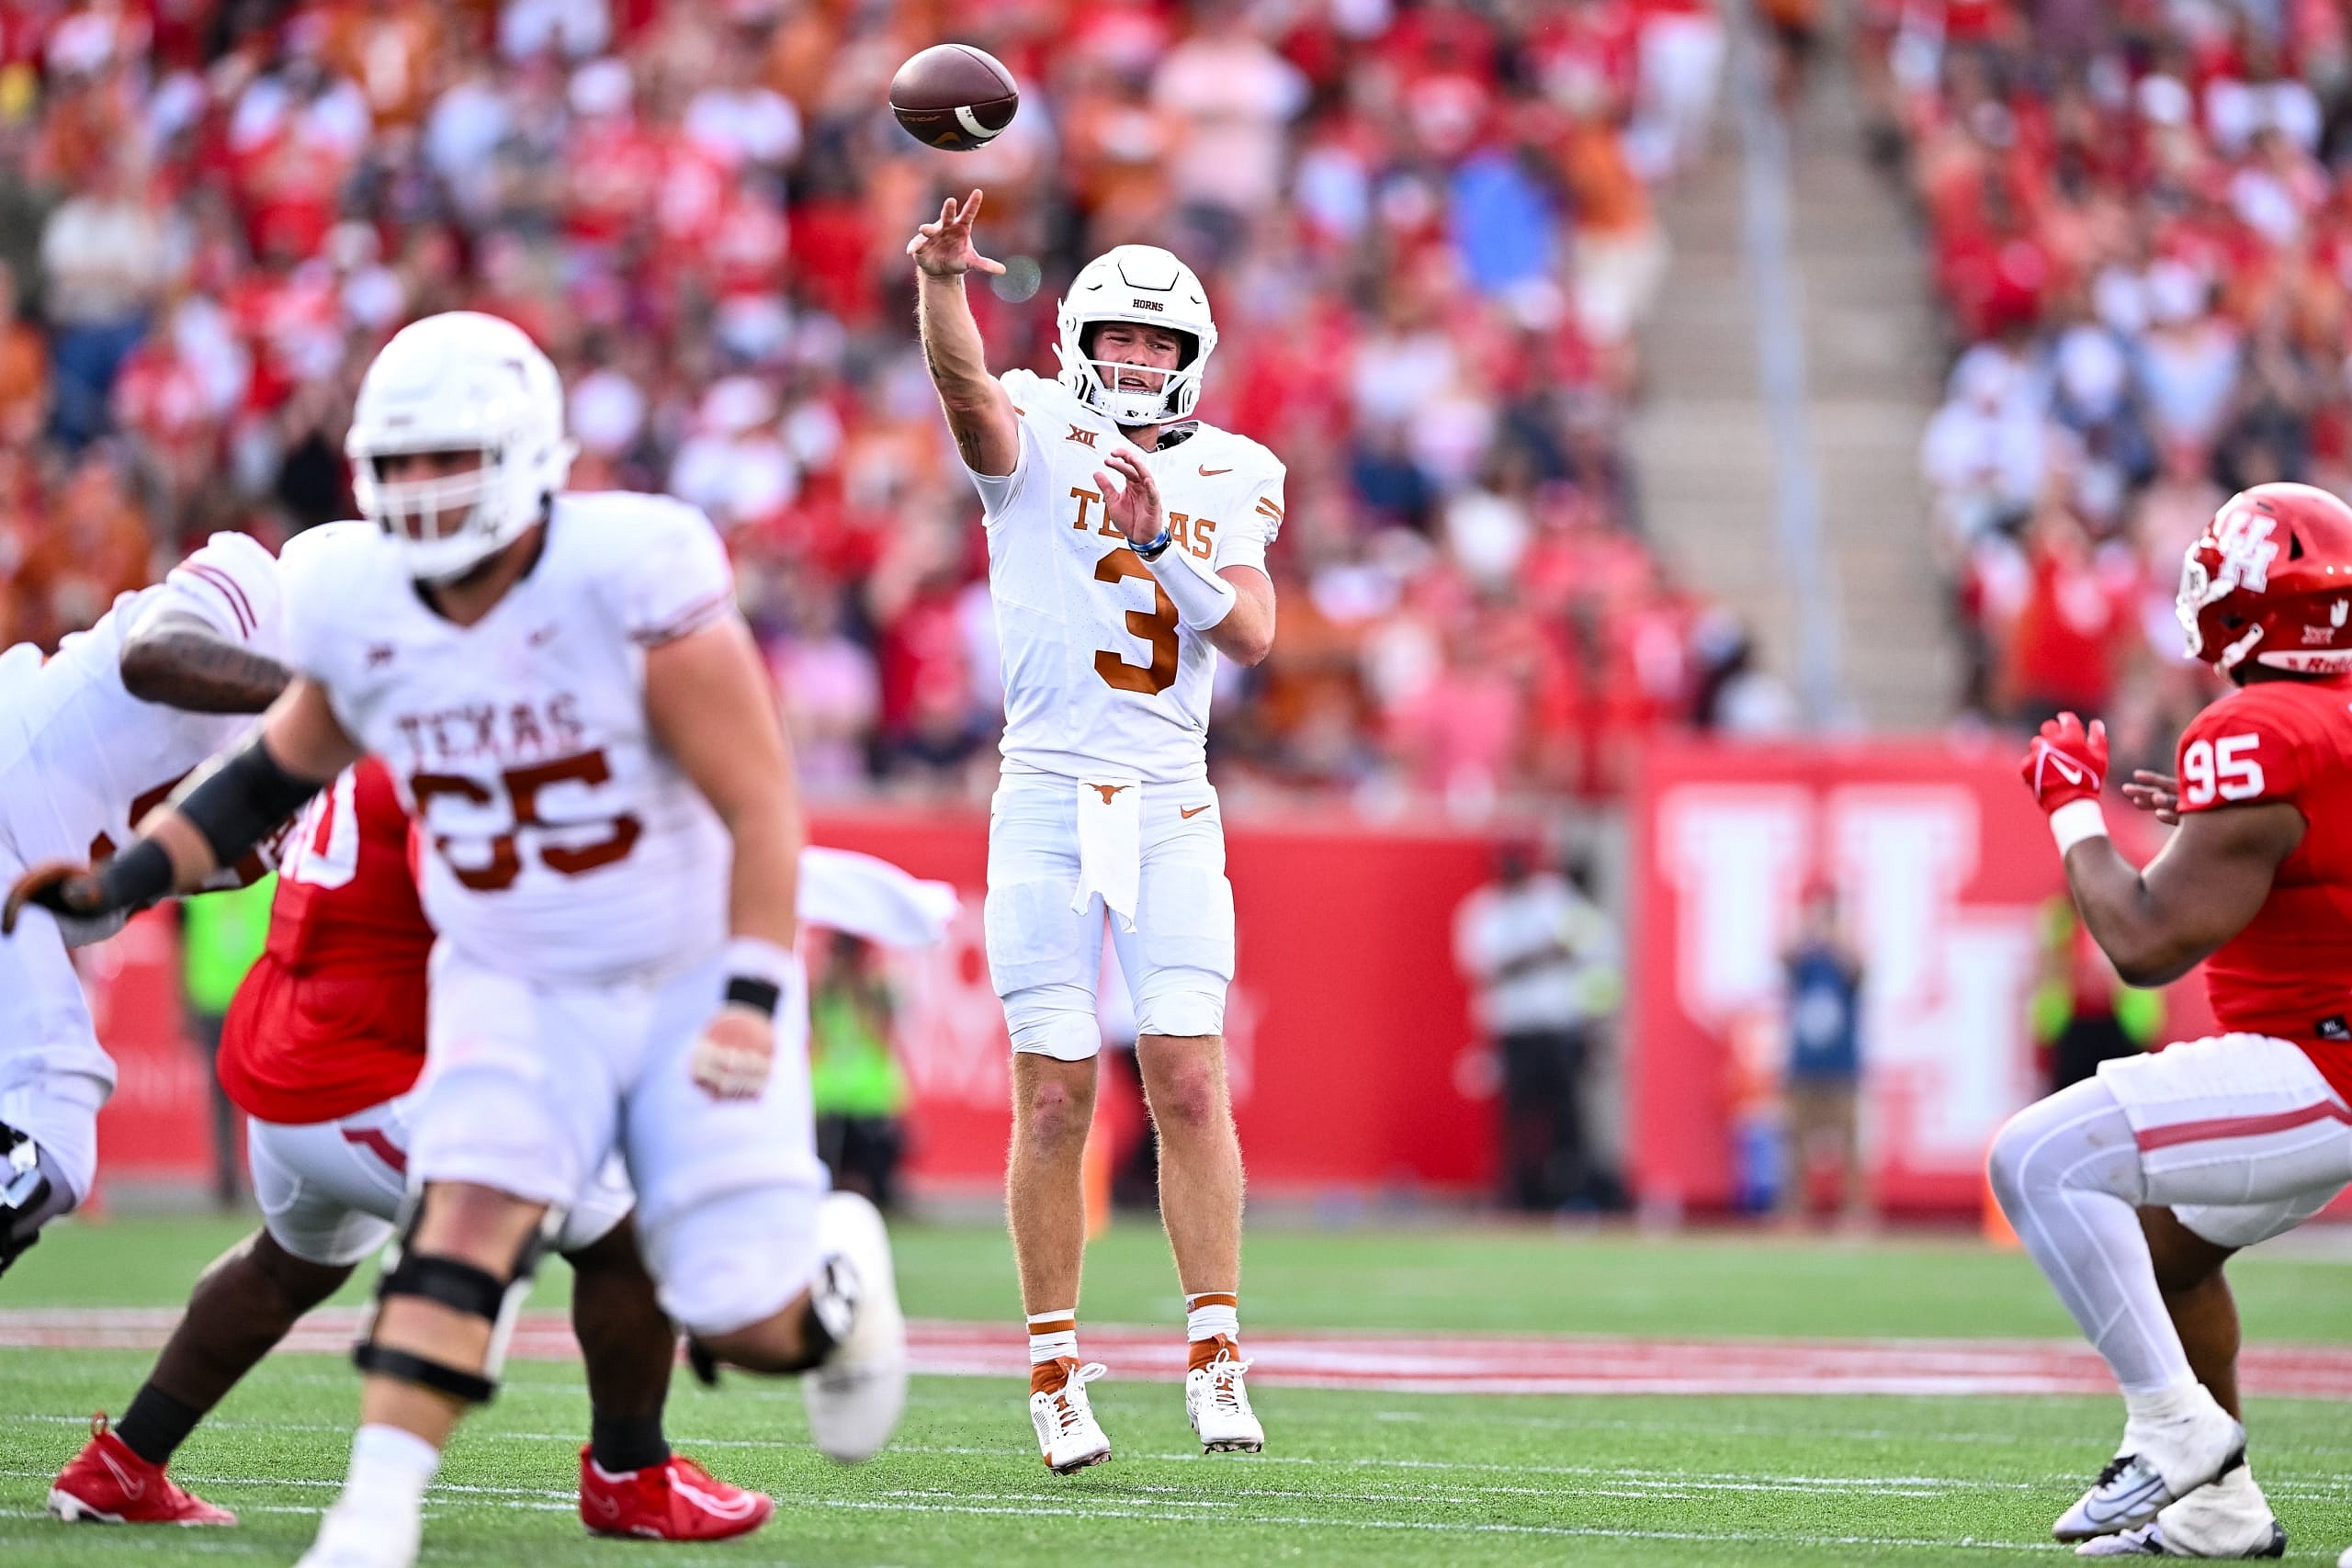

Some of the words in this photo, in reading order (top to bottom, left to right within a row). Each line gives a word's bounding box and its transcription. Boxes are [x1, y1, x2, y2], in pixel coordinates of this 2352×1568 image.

[1133, 299, 1164, 312] HORNS
[1070, 486, 1216, 560] TEAS
[1094, 547, 1180, 696] 3
[395, 692, 585, 770] TEXAS
[2183, 732, 2266, 805] 95
[410, 749, 642, 892] 65
